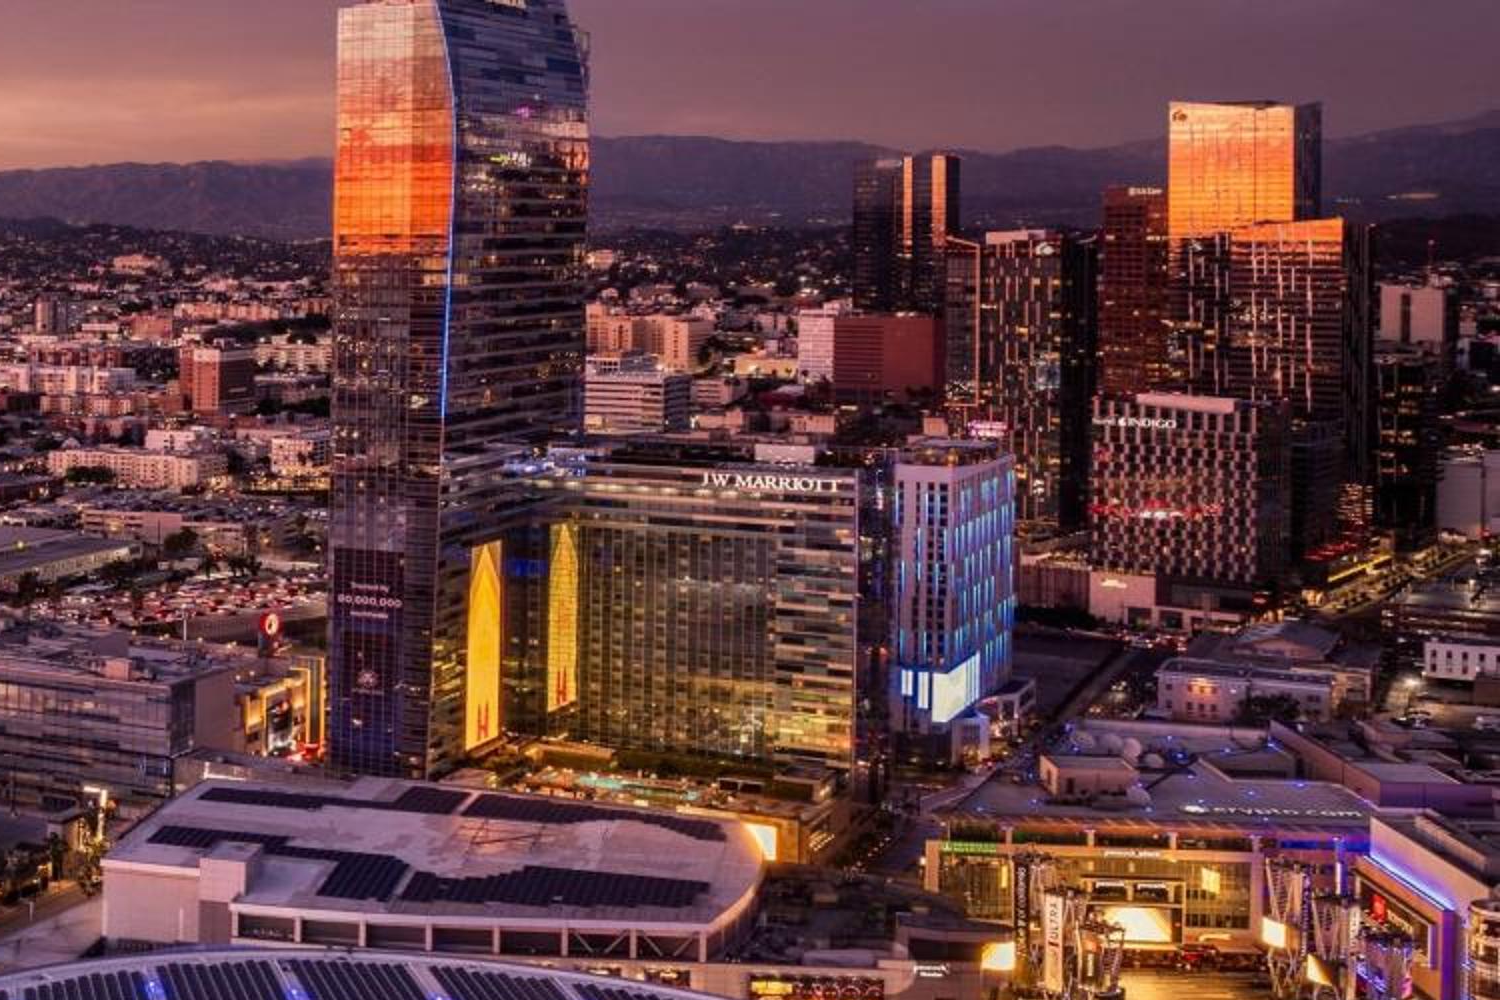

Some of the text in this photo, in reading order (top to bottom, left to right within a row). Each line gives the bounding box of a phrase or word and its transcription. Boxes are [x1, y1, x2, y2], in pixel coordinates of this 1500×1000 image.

[700, 472, 843, 493] JW MARRIOTT
[1048, 903, 1059, 940] ULTRA
